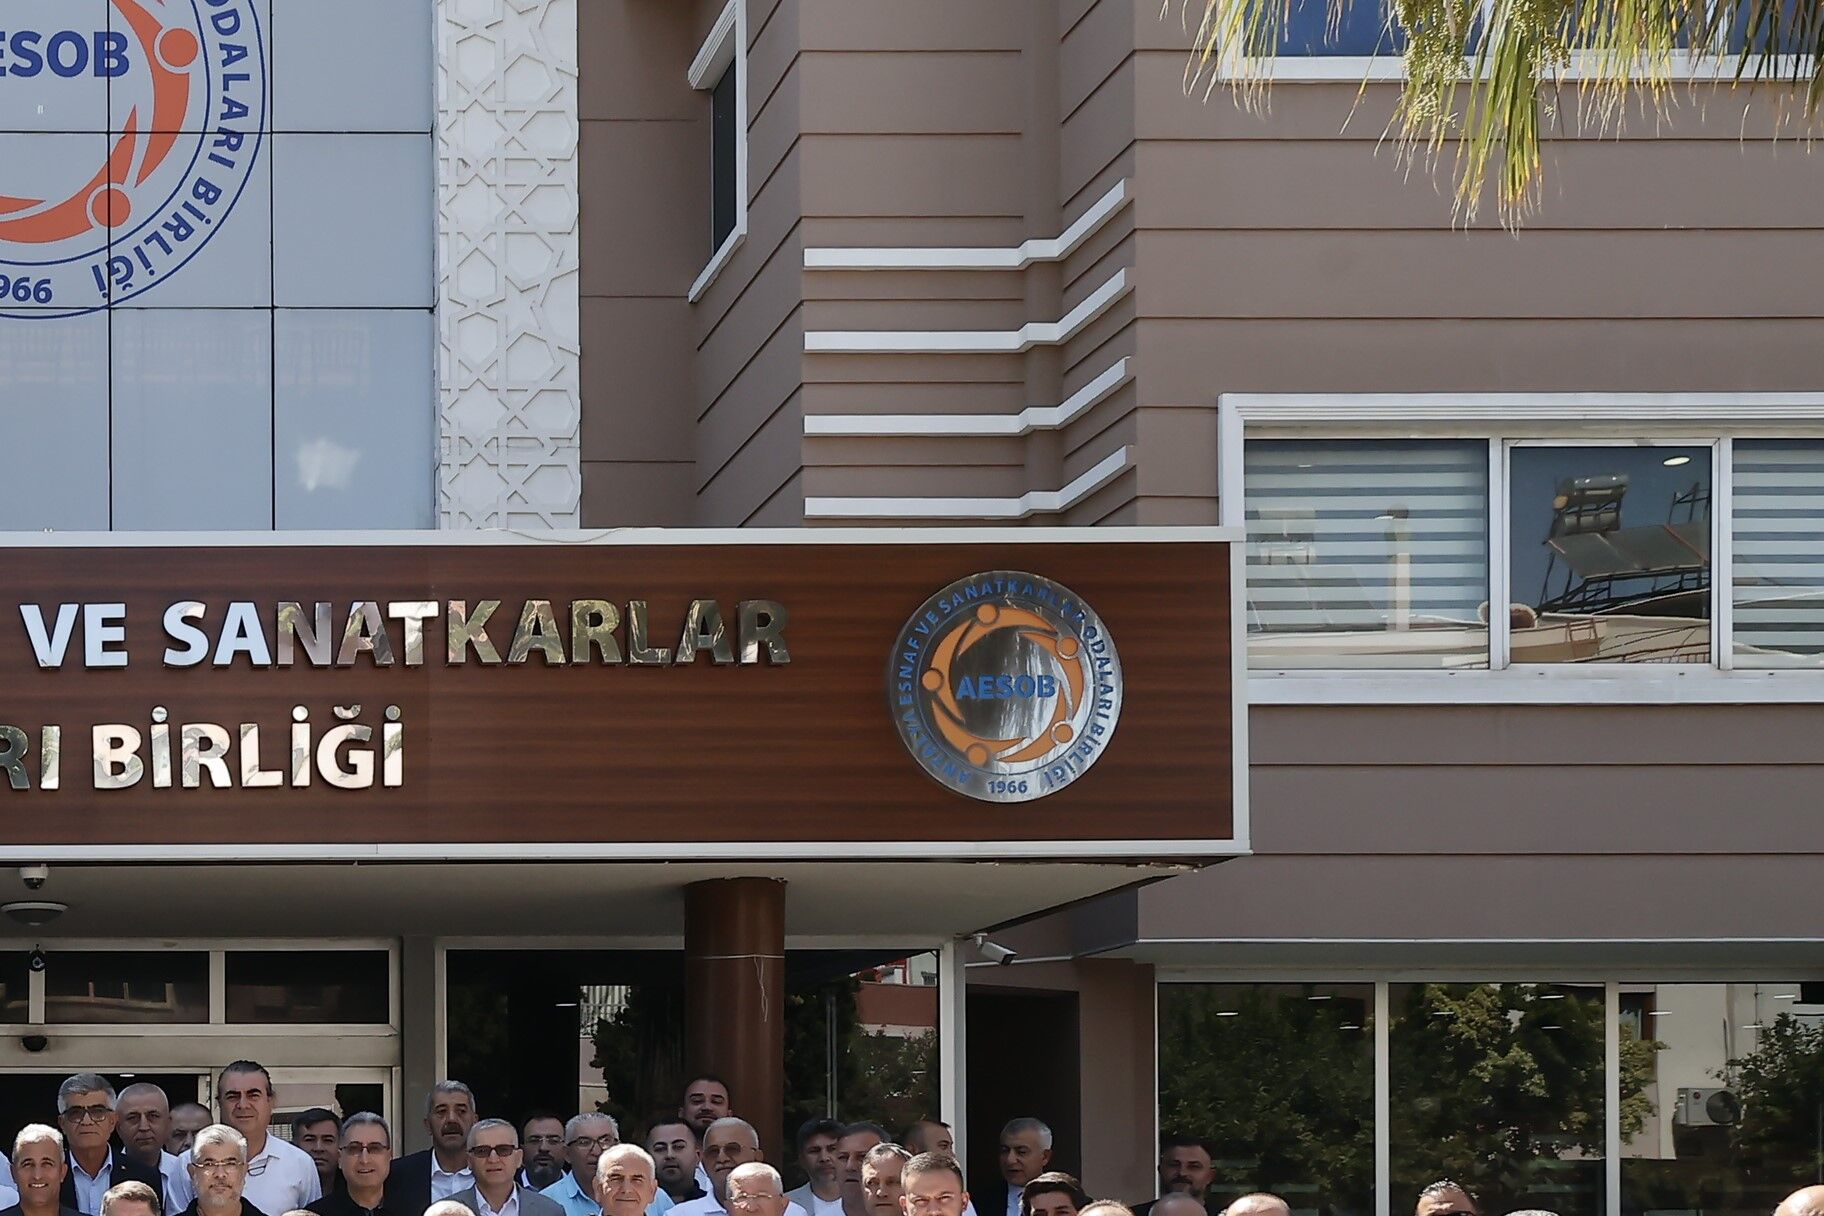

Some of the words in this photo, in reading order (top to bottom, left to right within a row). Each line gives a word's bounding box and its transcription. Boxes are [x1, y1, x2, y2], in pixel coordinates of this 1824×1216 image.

[205, 0, 250, 169] DALARI
[91, 176, 223, 298] BİRLİĞİ
[19, 602, 129, 668] VE
[161, 599, 792, 668] SANATKARLAR
[914, 610, 939, 635] VE
[898, 636, 921, 705] ESNAF
[956, 673, 1056, 701] AESOB
[1083, 625, 1114, 720] ODALARI
[91, 704, 405, 790] BİRLİĞİ
[1044, 722, 1105, 788] BİRLİĞİ
[987, 780, 1028, 794] 1966
